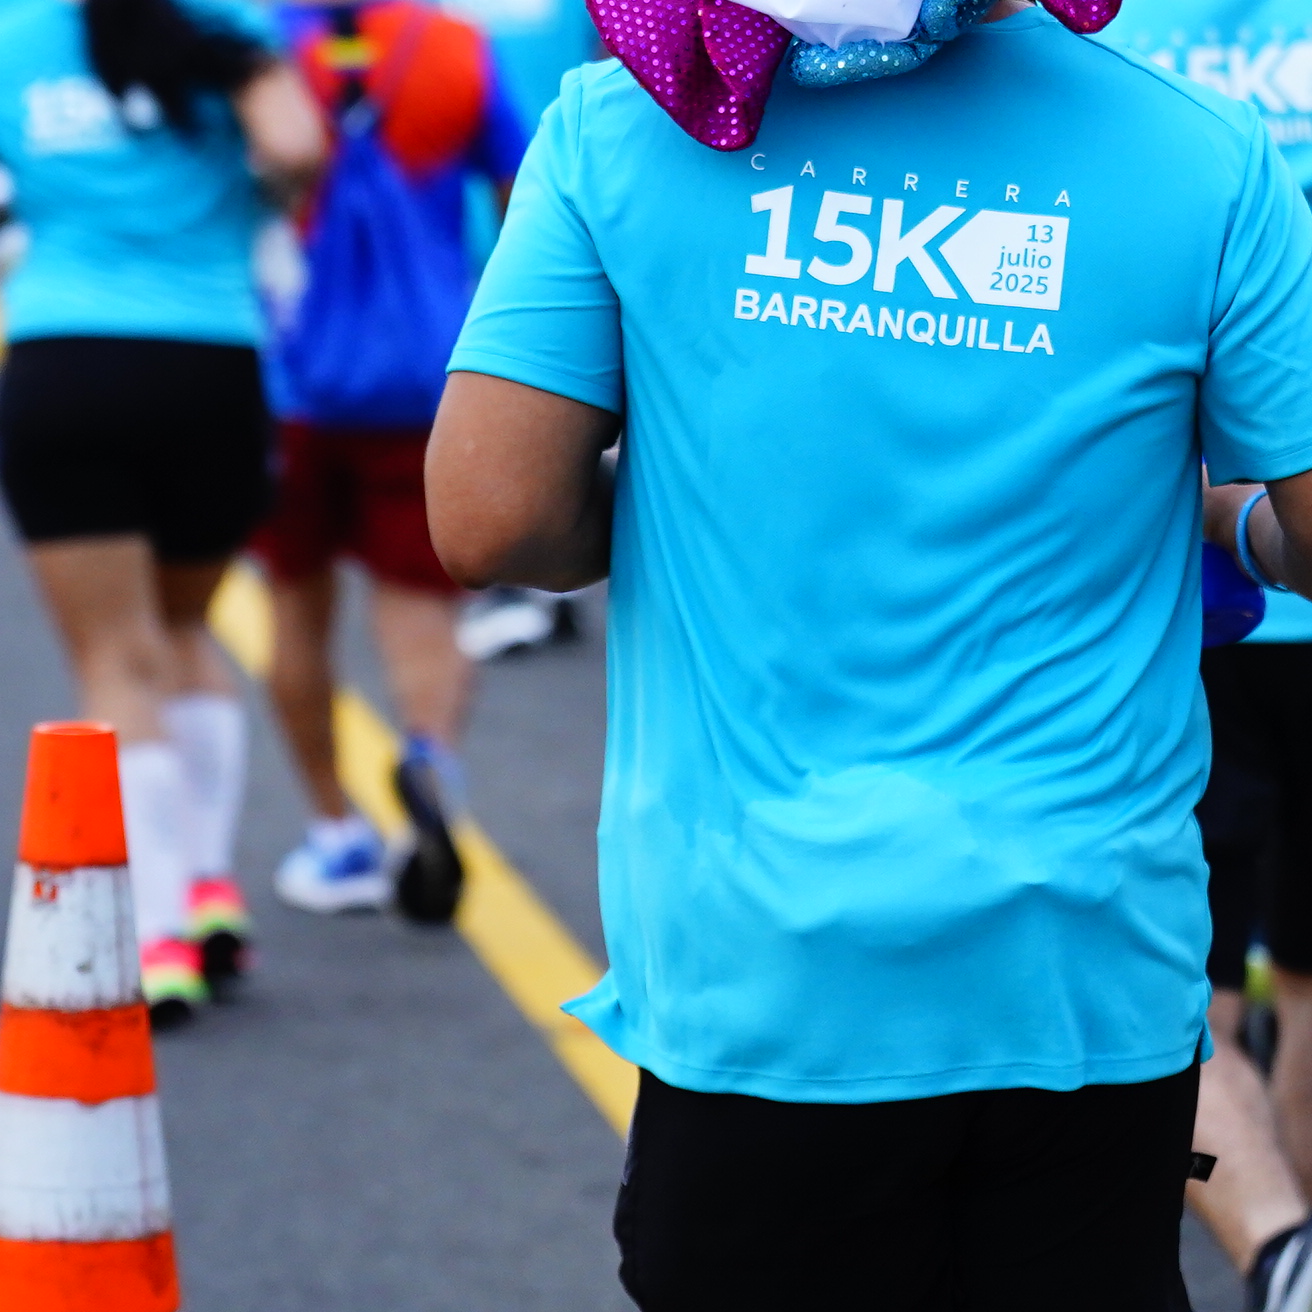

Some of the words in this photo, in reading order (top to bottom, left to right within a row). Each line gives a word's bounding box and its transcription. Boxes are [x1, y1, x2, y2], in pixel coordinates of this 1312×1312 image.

[751, 153, 1071, 207] CARRERA
[744, 185, 966, 299] 15K
[1027, 224, 1054, 244] 13
[997, 246, 1052, 271] julio
[990, 272, 1049, 295] 2025
[734, 288, 1054, 356] BARRANQUILLA
